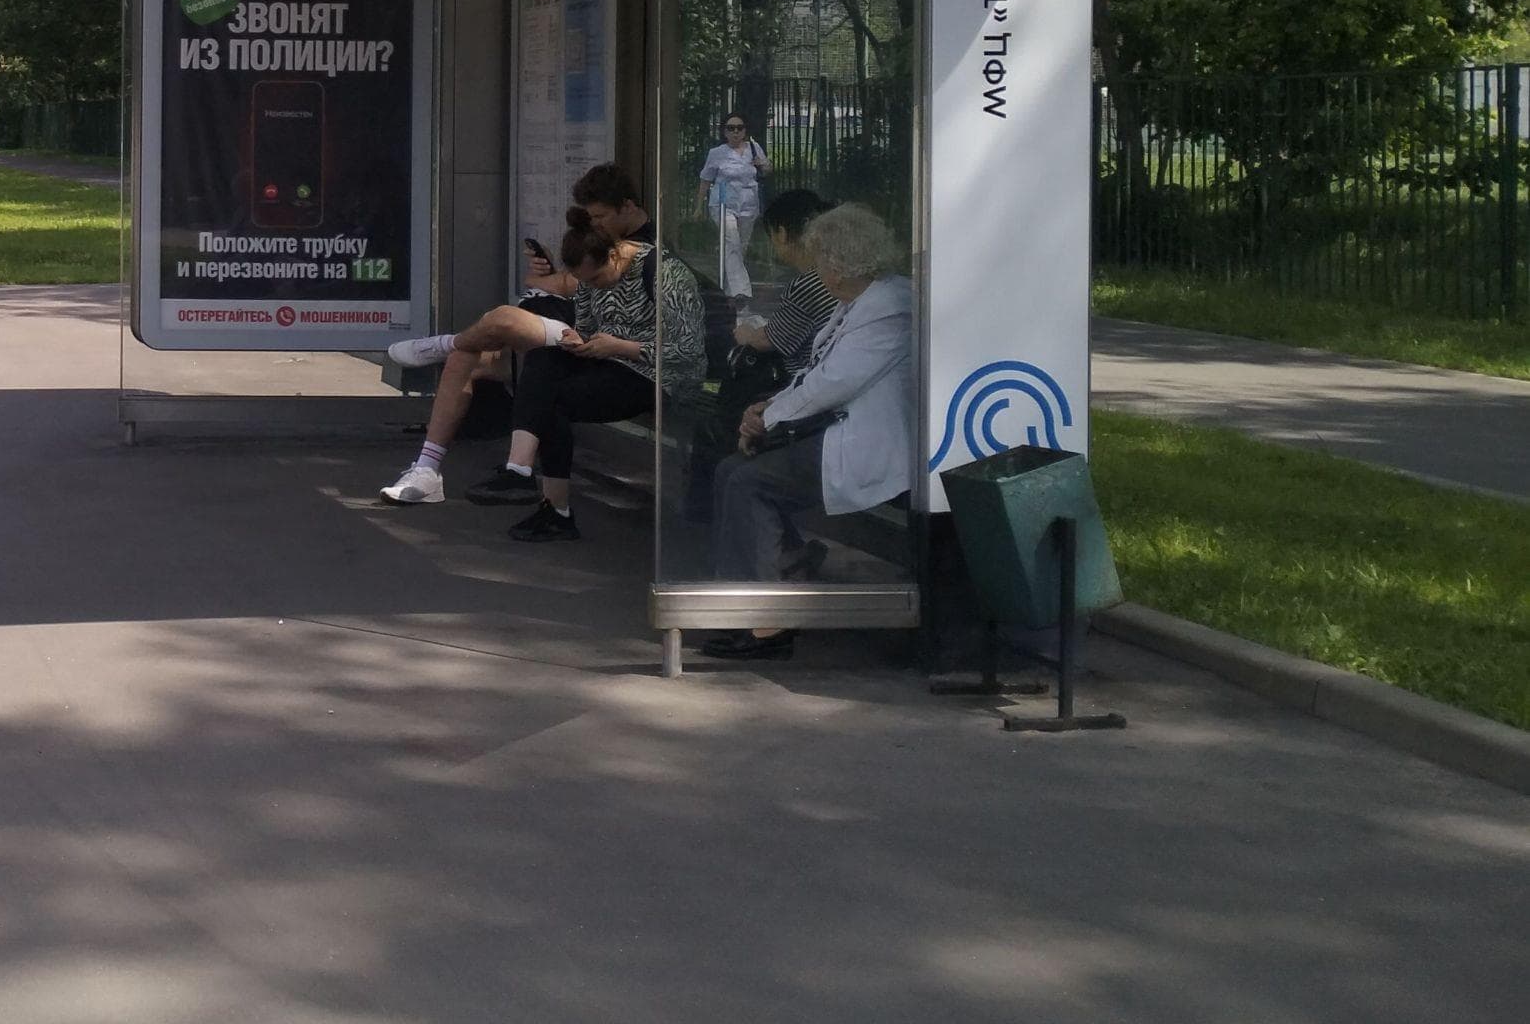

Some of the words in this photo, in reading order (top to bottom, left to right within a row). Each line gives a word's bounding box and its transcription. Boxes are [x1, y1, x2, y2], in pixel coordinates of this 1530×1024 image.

[228, 2, 350, 35] ЗВОНЯТ
[179, 38, 220, 71] ИЗ
[228, 38, 395, 78] ПОЛИЦИИ?
[983, 33, 1012, 118] МФЦ
[198, 231, 298, 255] Положите
[302, 233, 369, 259] трубку
[177, 260, 190, 278] и
[195, 260, 319, 283] перезвоните
[323, 261, 348, 279] на
[352, 258, 390, 280] 112
[177, 308, 273, 323] ОСТЕРЕГАЙТЕСЬ
[299, 310, 393, 325] МОШЕННИКОВ!
